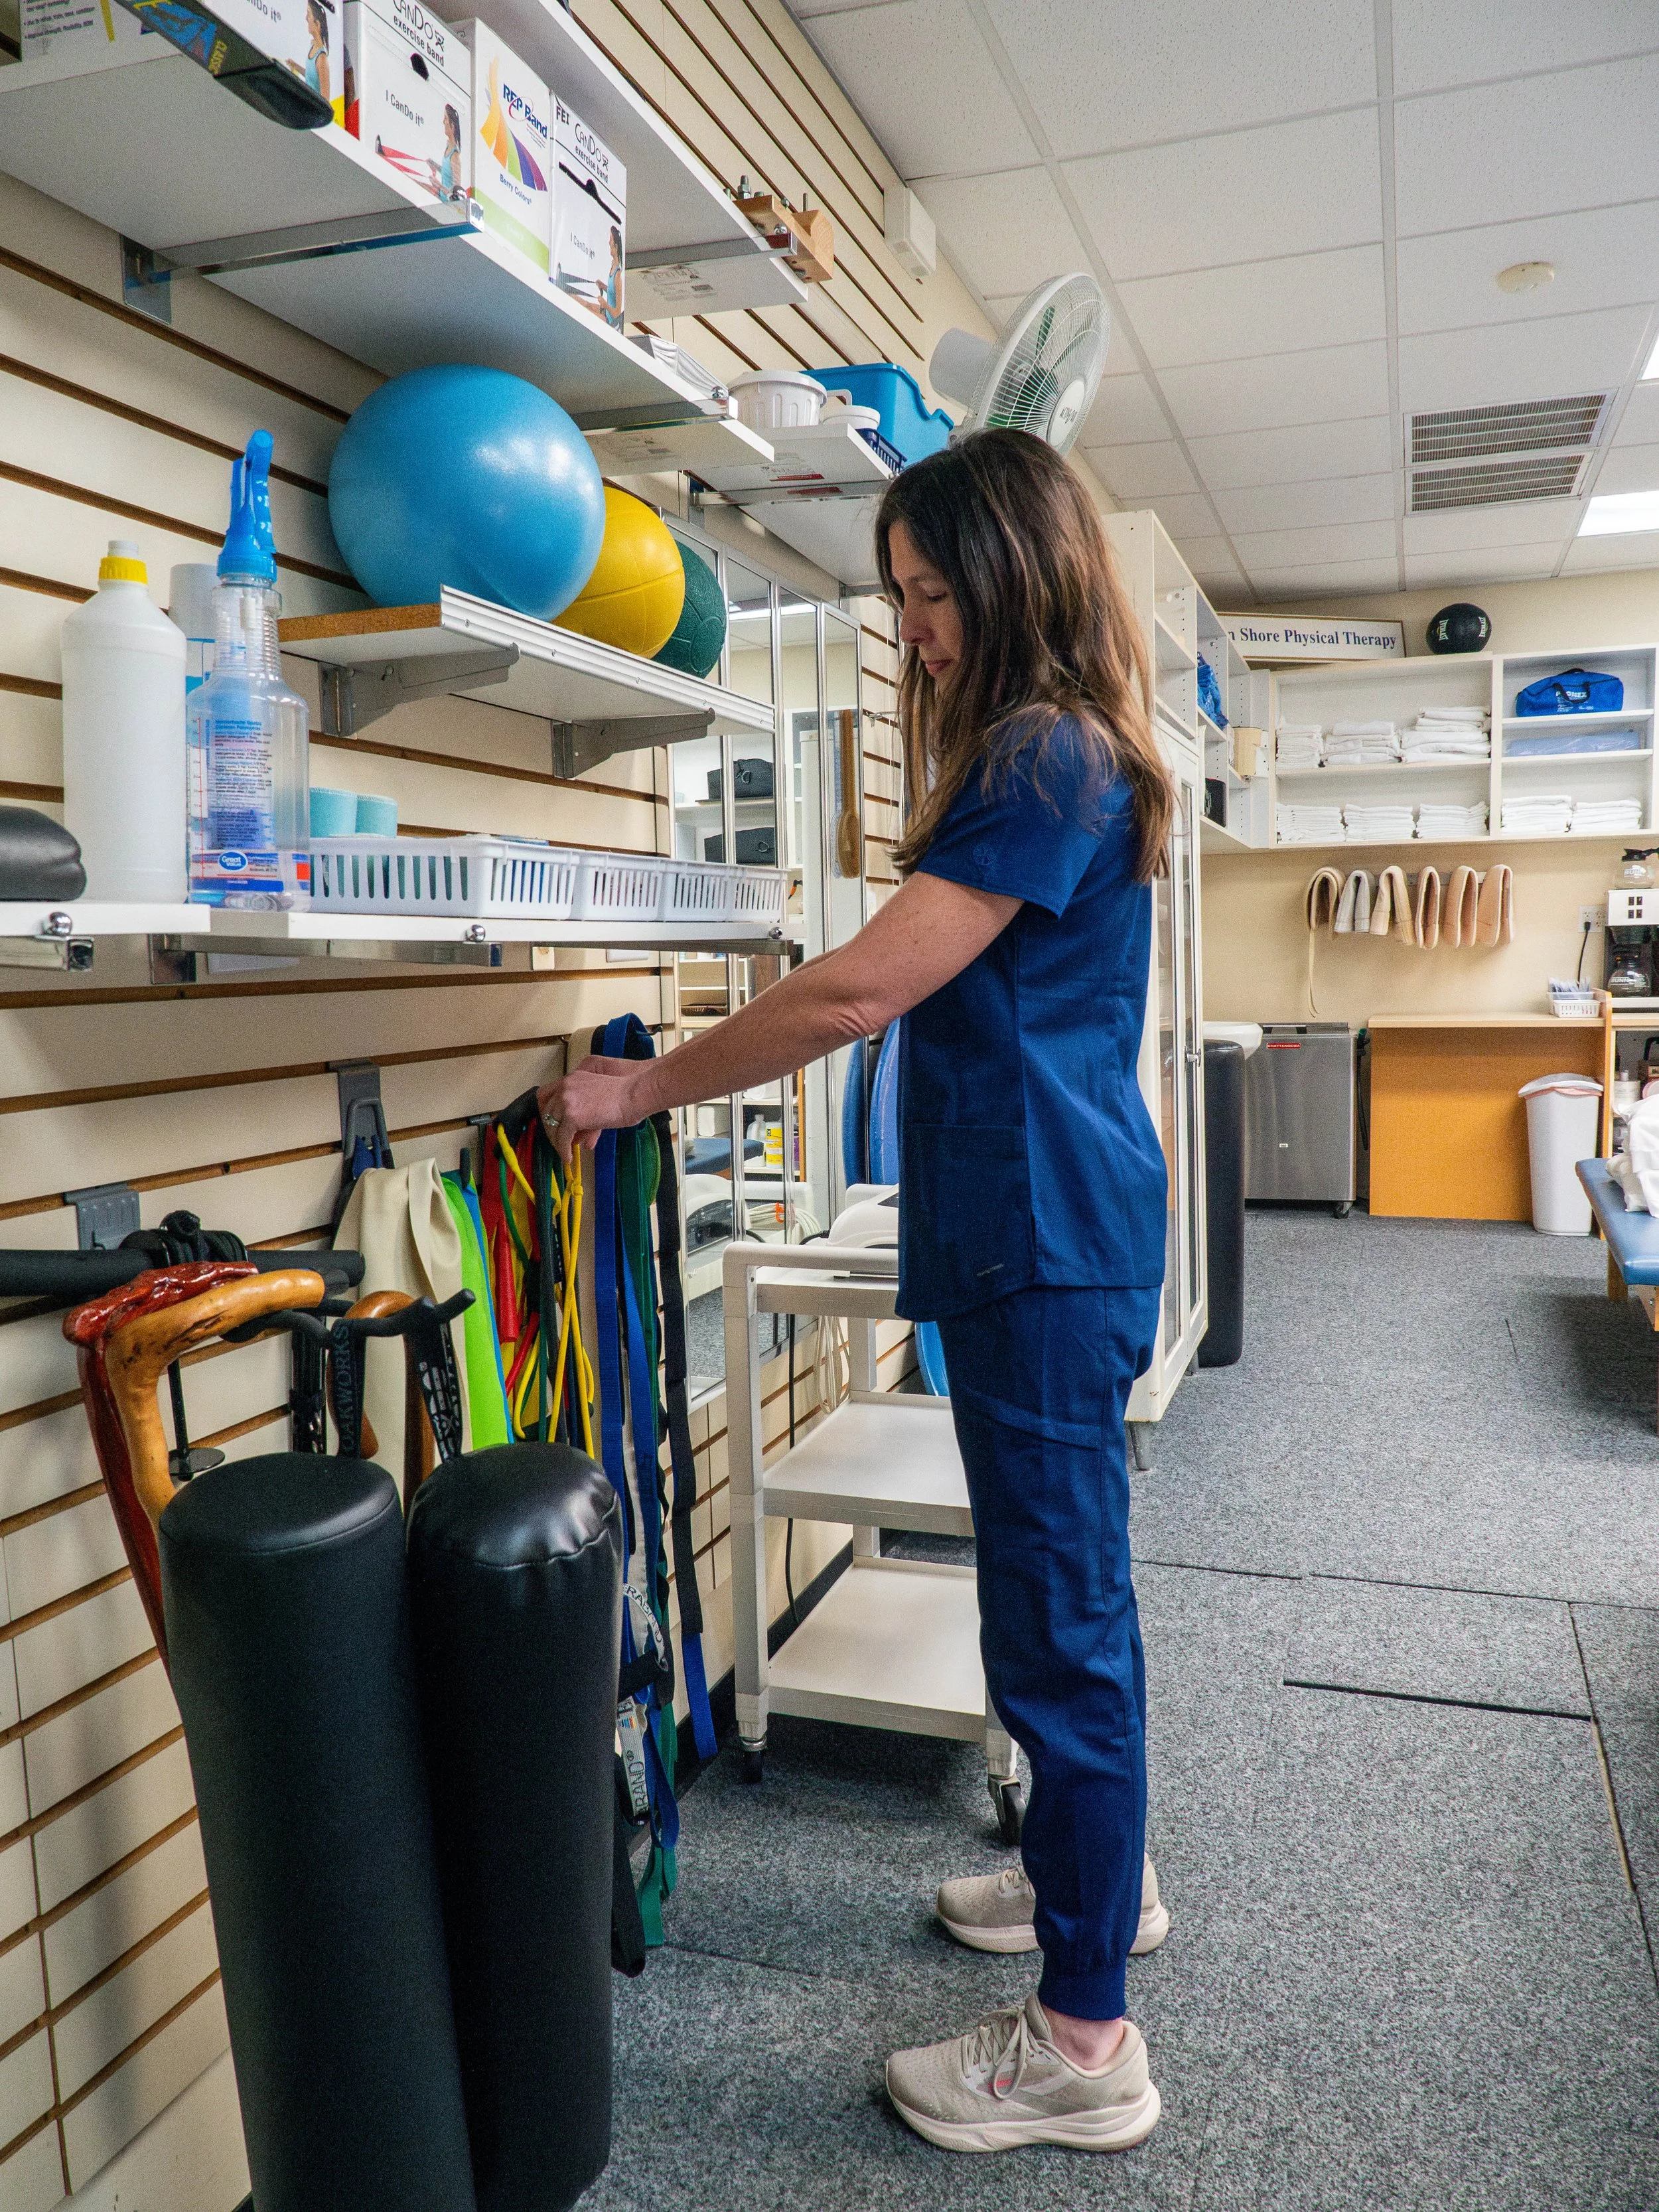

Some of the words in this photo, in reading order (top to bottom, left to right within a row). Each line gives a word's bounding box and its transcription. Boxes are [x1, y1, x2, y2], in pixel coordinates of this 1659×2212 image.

[394, 15, 425, 50] exercise
[427, 42, 445, 67] band
[391, 94, 413, 121] CanDo
[503, 84, 523, 111] REP
[524, 104, 547, 139] Band
[555, 106, 569, 125] FEI
[575, 145, 596, 173] exercise
[597, 165, 609, 184] band
[500, 173, 514, 192] Berry
[573, 236, 589, 256] CanDo
[1240, 627, 1280, 642] Shore
[1284, 629, 1340, 646] Physical
[1342, 631, 1397, 650] Therapy
[333, 1325, 355, 1453] OAKWORKS
